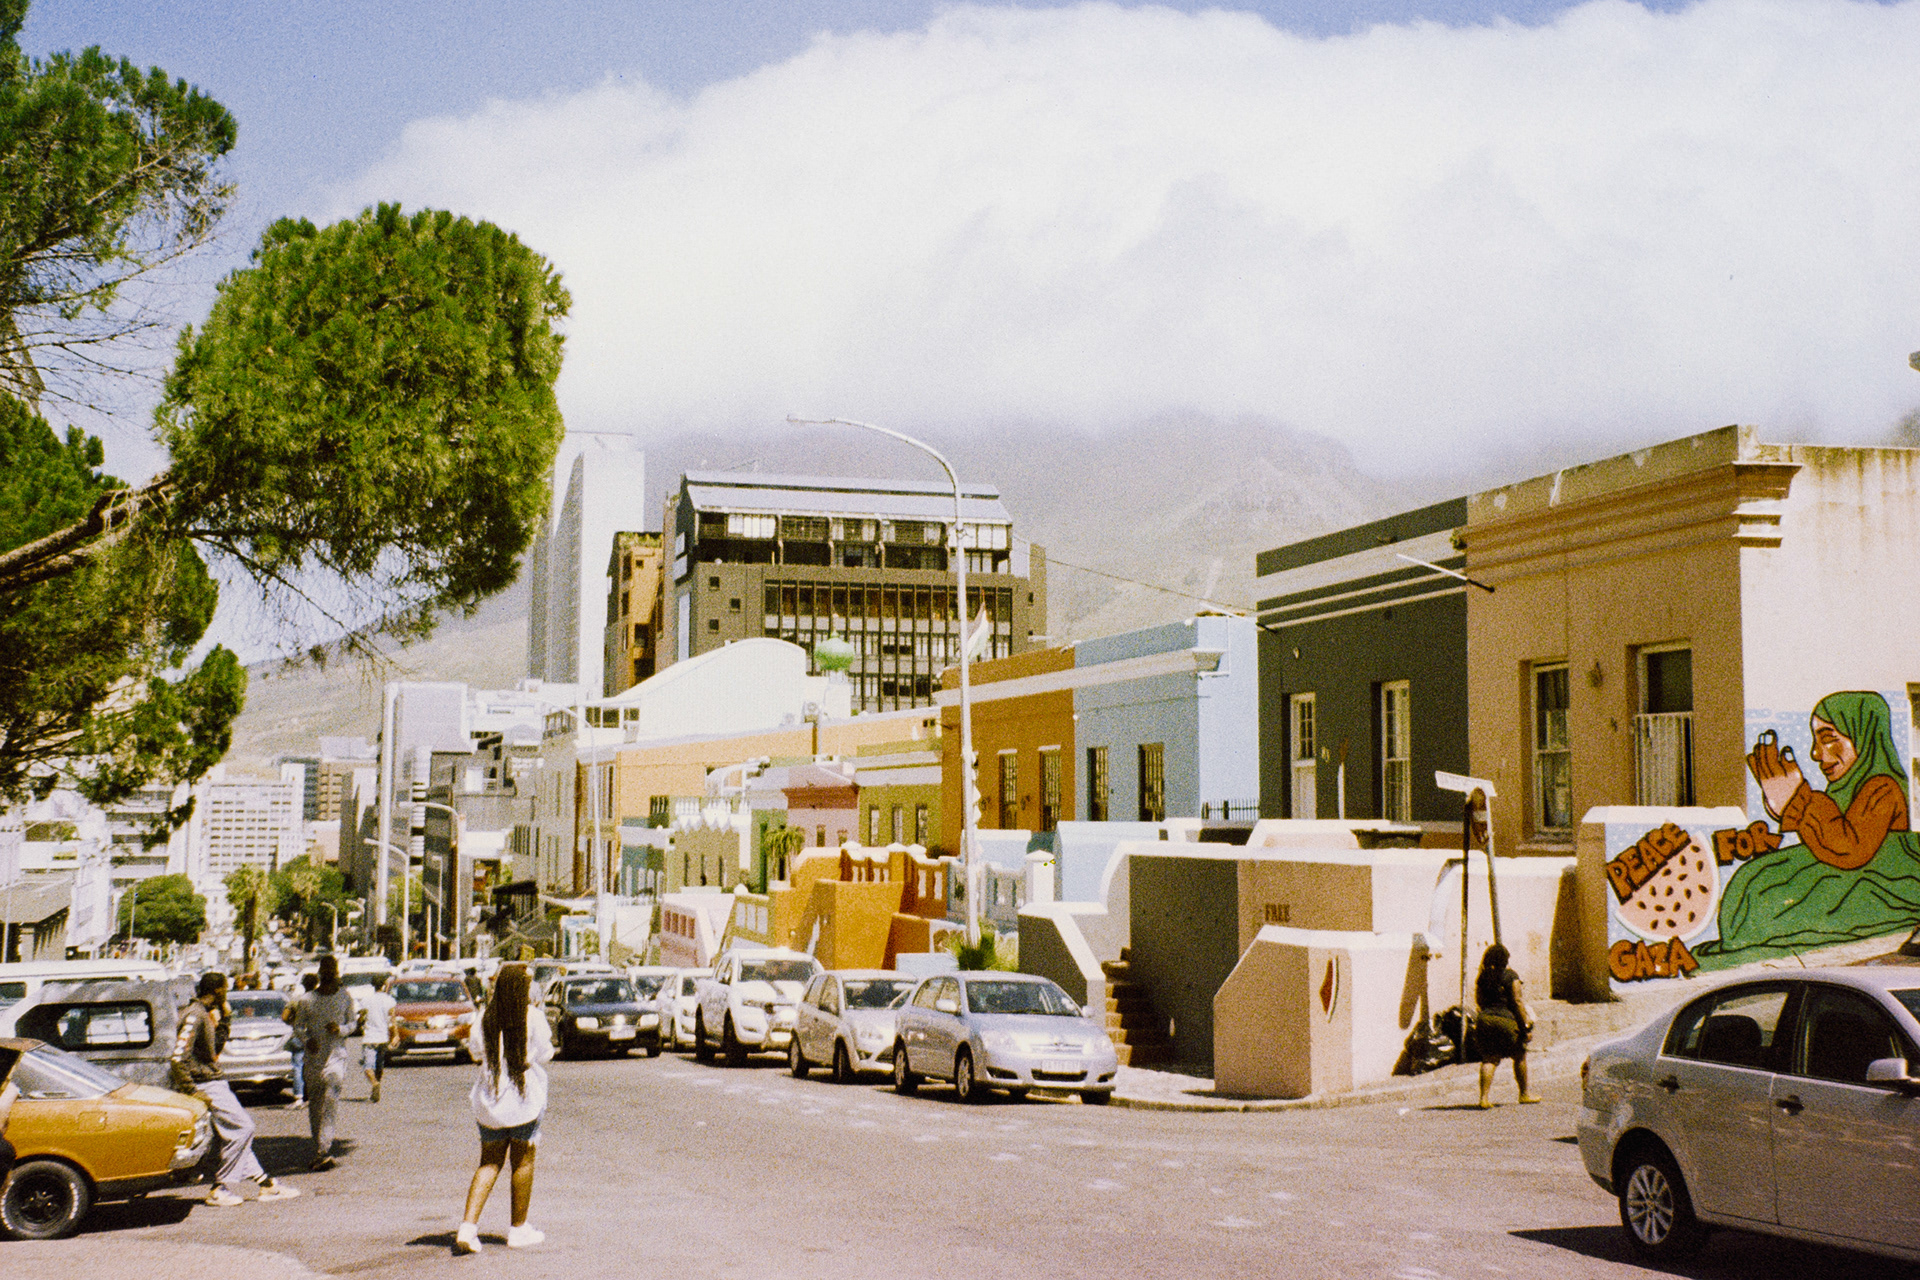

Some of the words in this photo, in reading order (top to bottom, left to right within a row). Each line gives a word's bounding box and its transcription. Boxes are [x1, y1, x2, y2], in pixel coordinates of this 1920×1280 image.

[1605, 822, 1692, 906] PEACE
[1712, 820, 1784, 866] FOR
[1608, 936, 1699, 983] GAZA
